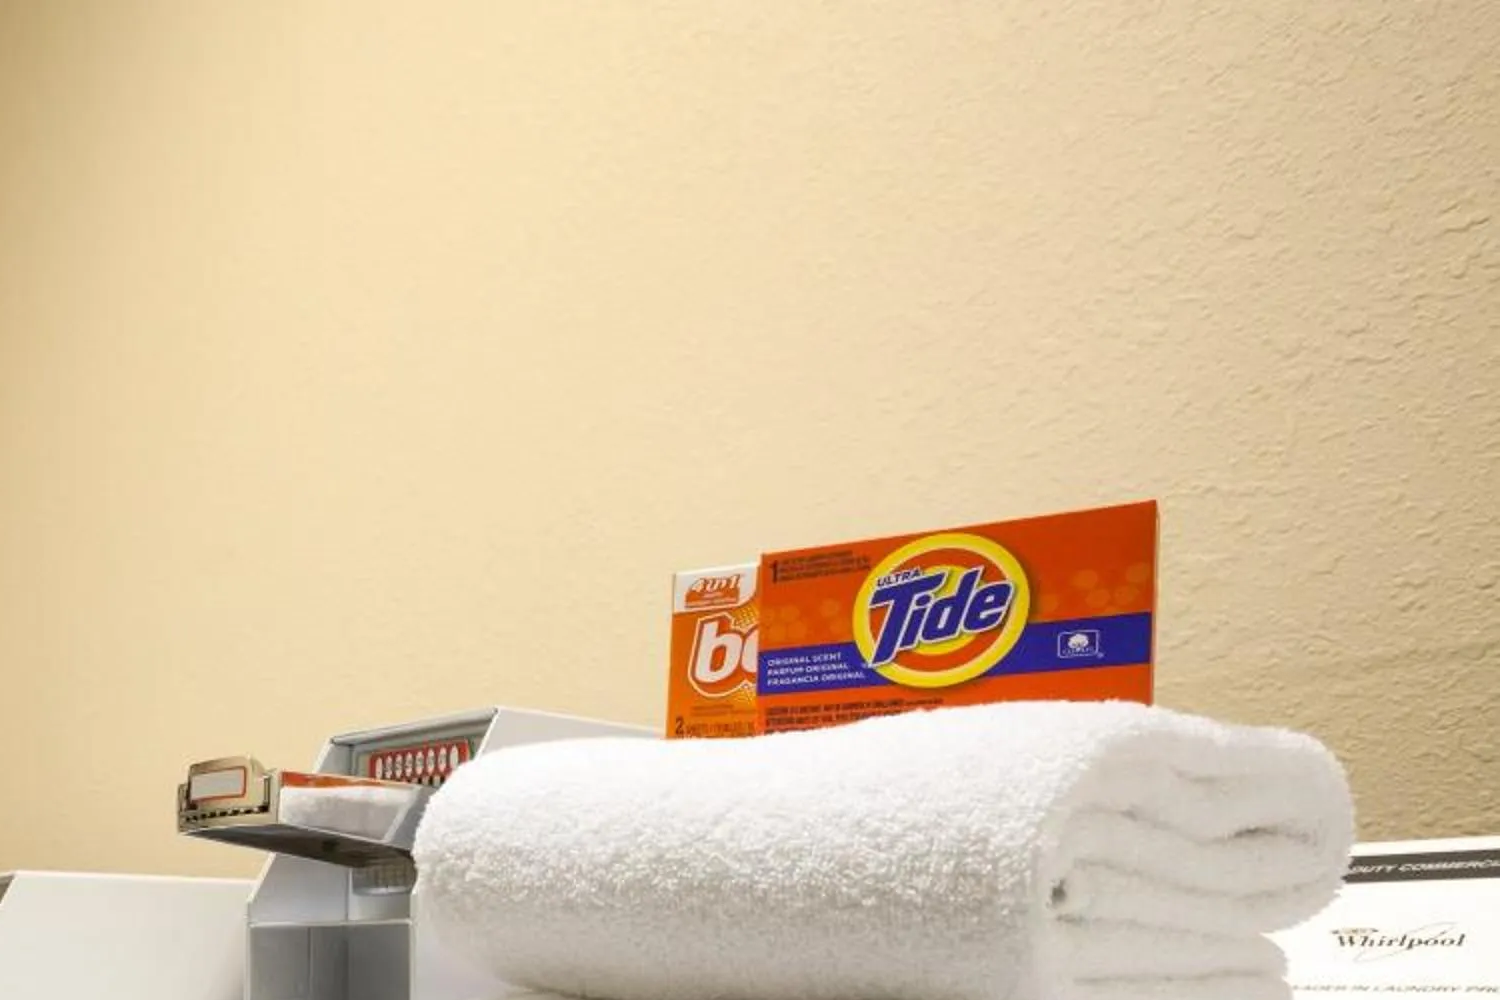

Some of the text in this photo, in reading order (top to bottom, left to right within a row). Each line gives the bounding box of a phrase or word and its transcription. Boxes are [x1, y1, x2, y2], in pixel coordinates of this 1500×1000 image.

[876, 566, 923, 587] ULTRA
[869, 566, 1014, 667] Tide
[767, 652, 842, 667] ORIGINAL SCENT
[767, 663, 849, 676] PARFUM ORIGINAL
[821, 671, 865, 682] ORIGINAL
[1331, 929, 1466, 951] Whirlpool
